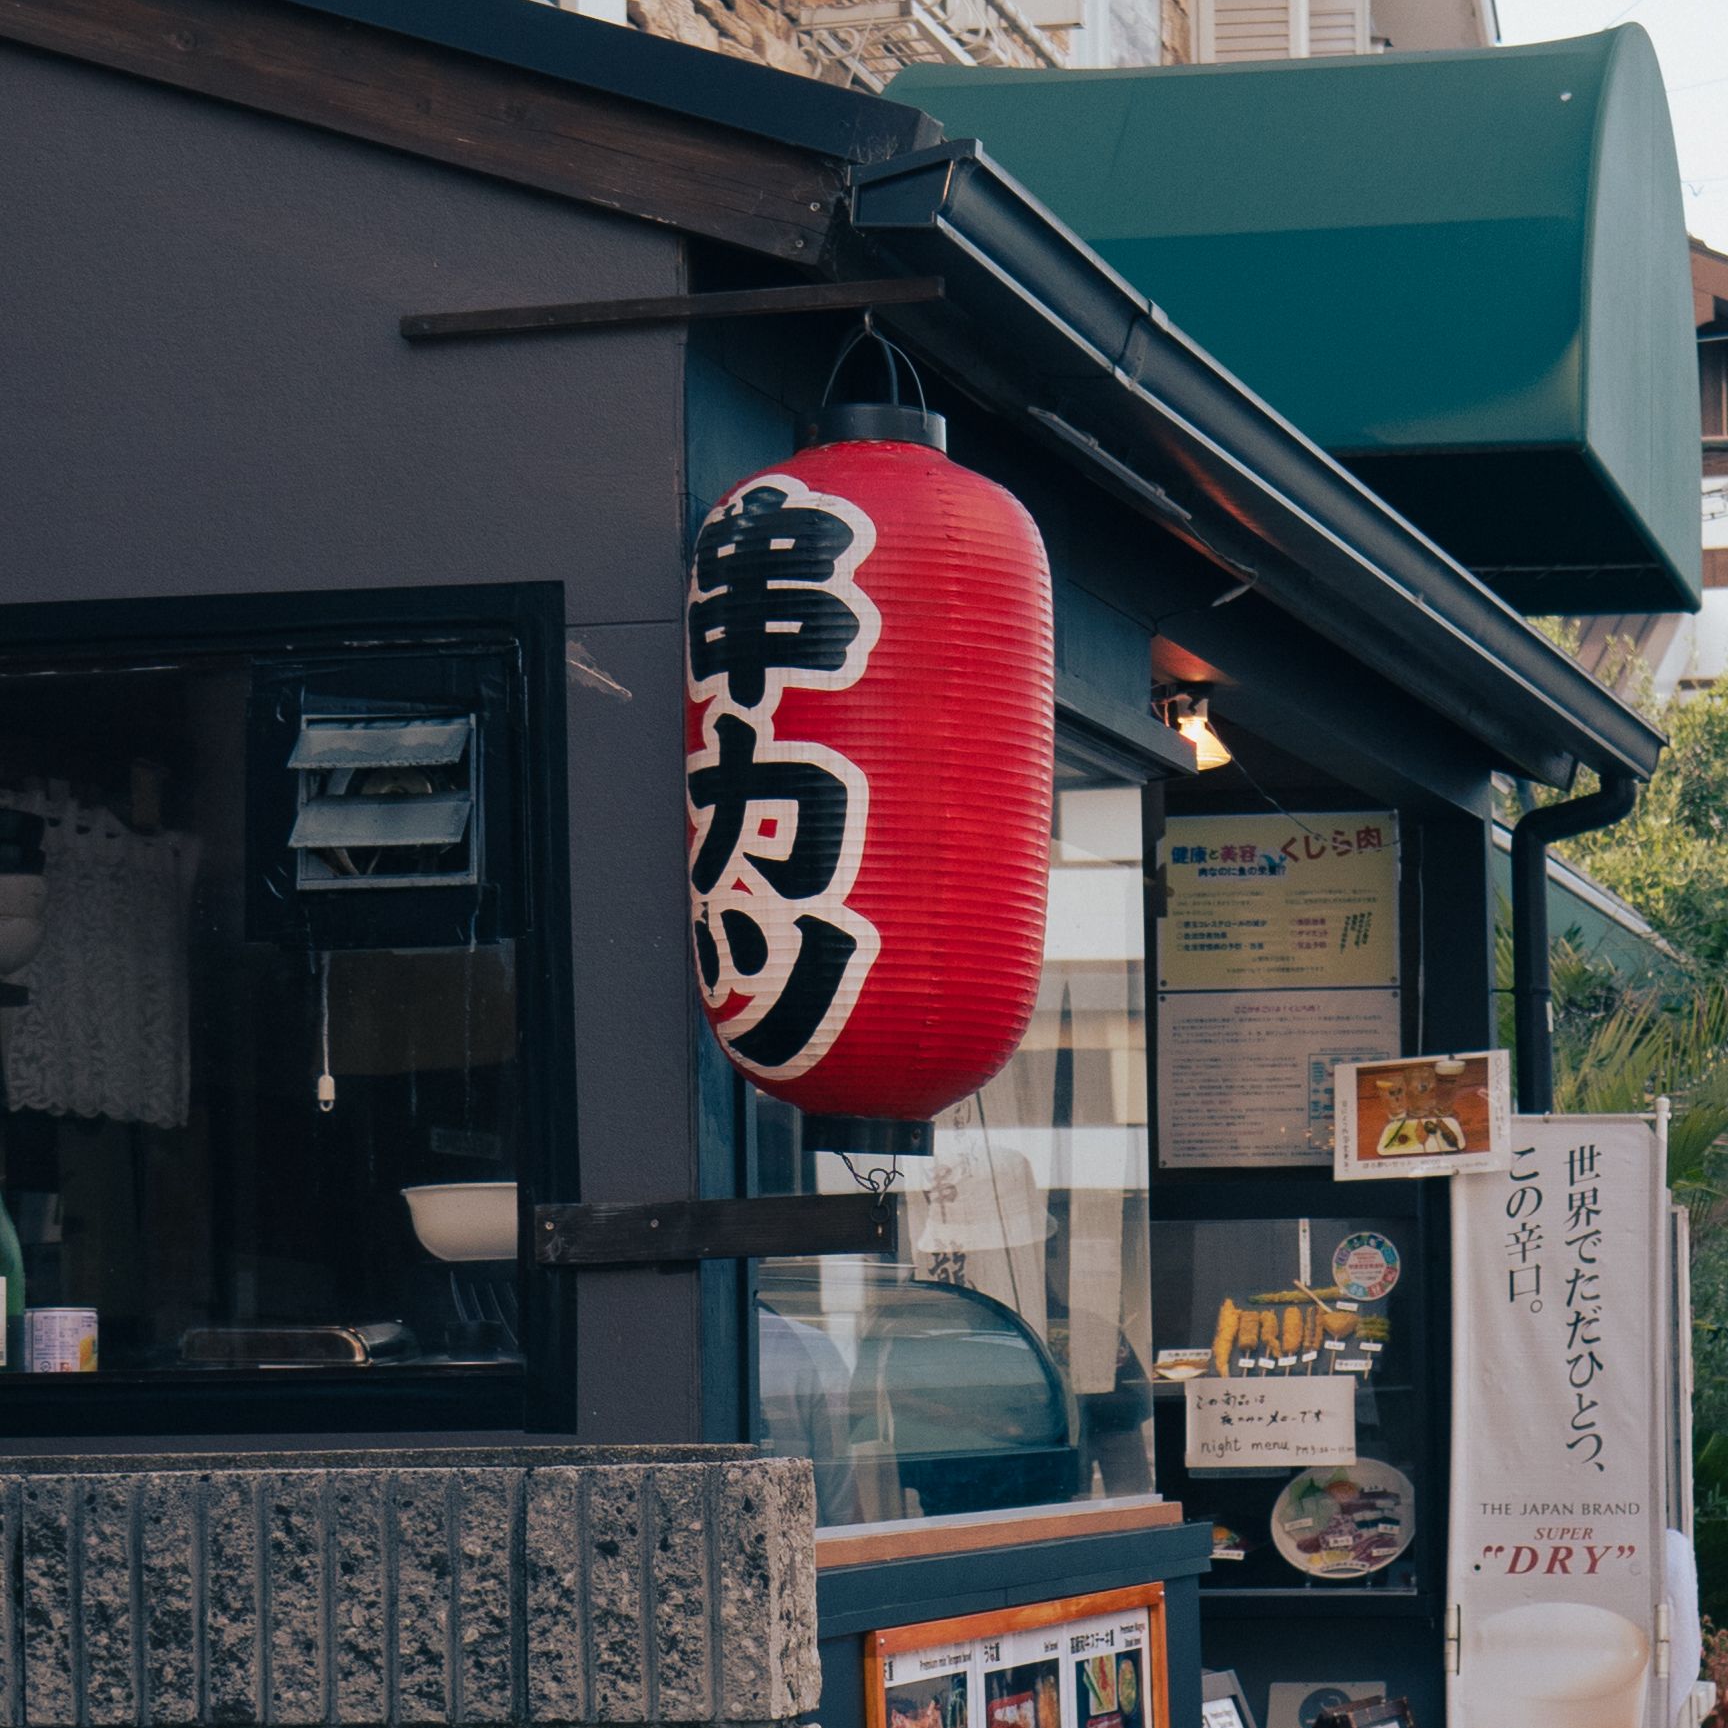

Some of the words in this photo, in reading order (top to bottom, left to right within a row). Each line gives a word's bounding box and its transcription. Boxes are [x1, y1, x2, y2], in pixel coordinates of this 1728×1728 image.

[687, 479, 868, 1074] 串カツ
[1171, 845, 1258, 865] 健康と美容
[1504, 1146, 1545, 1314] この辛口。
[1563, 1143, 1605, 1472] 世界でただひとつ、
[1201, 1436, 1241, 1458] night
[1252, 1441, 1290, 1451] menu
[1481, 1502, 1512, 1516] THE
[1520, 1502, 1575, 1516] JAPAN
[1581, 1502, 1641, 1516] BRAND
[1534, 1527, 1594, 1541] SUPER
[984, 1642, 1001, 1664] うな重
